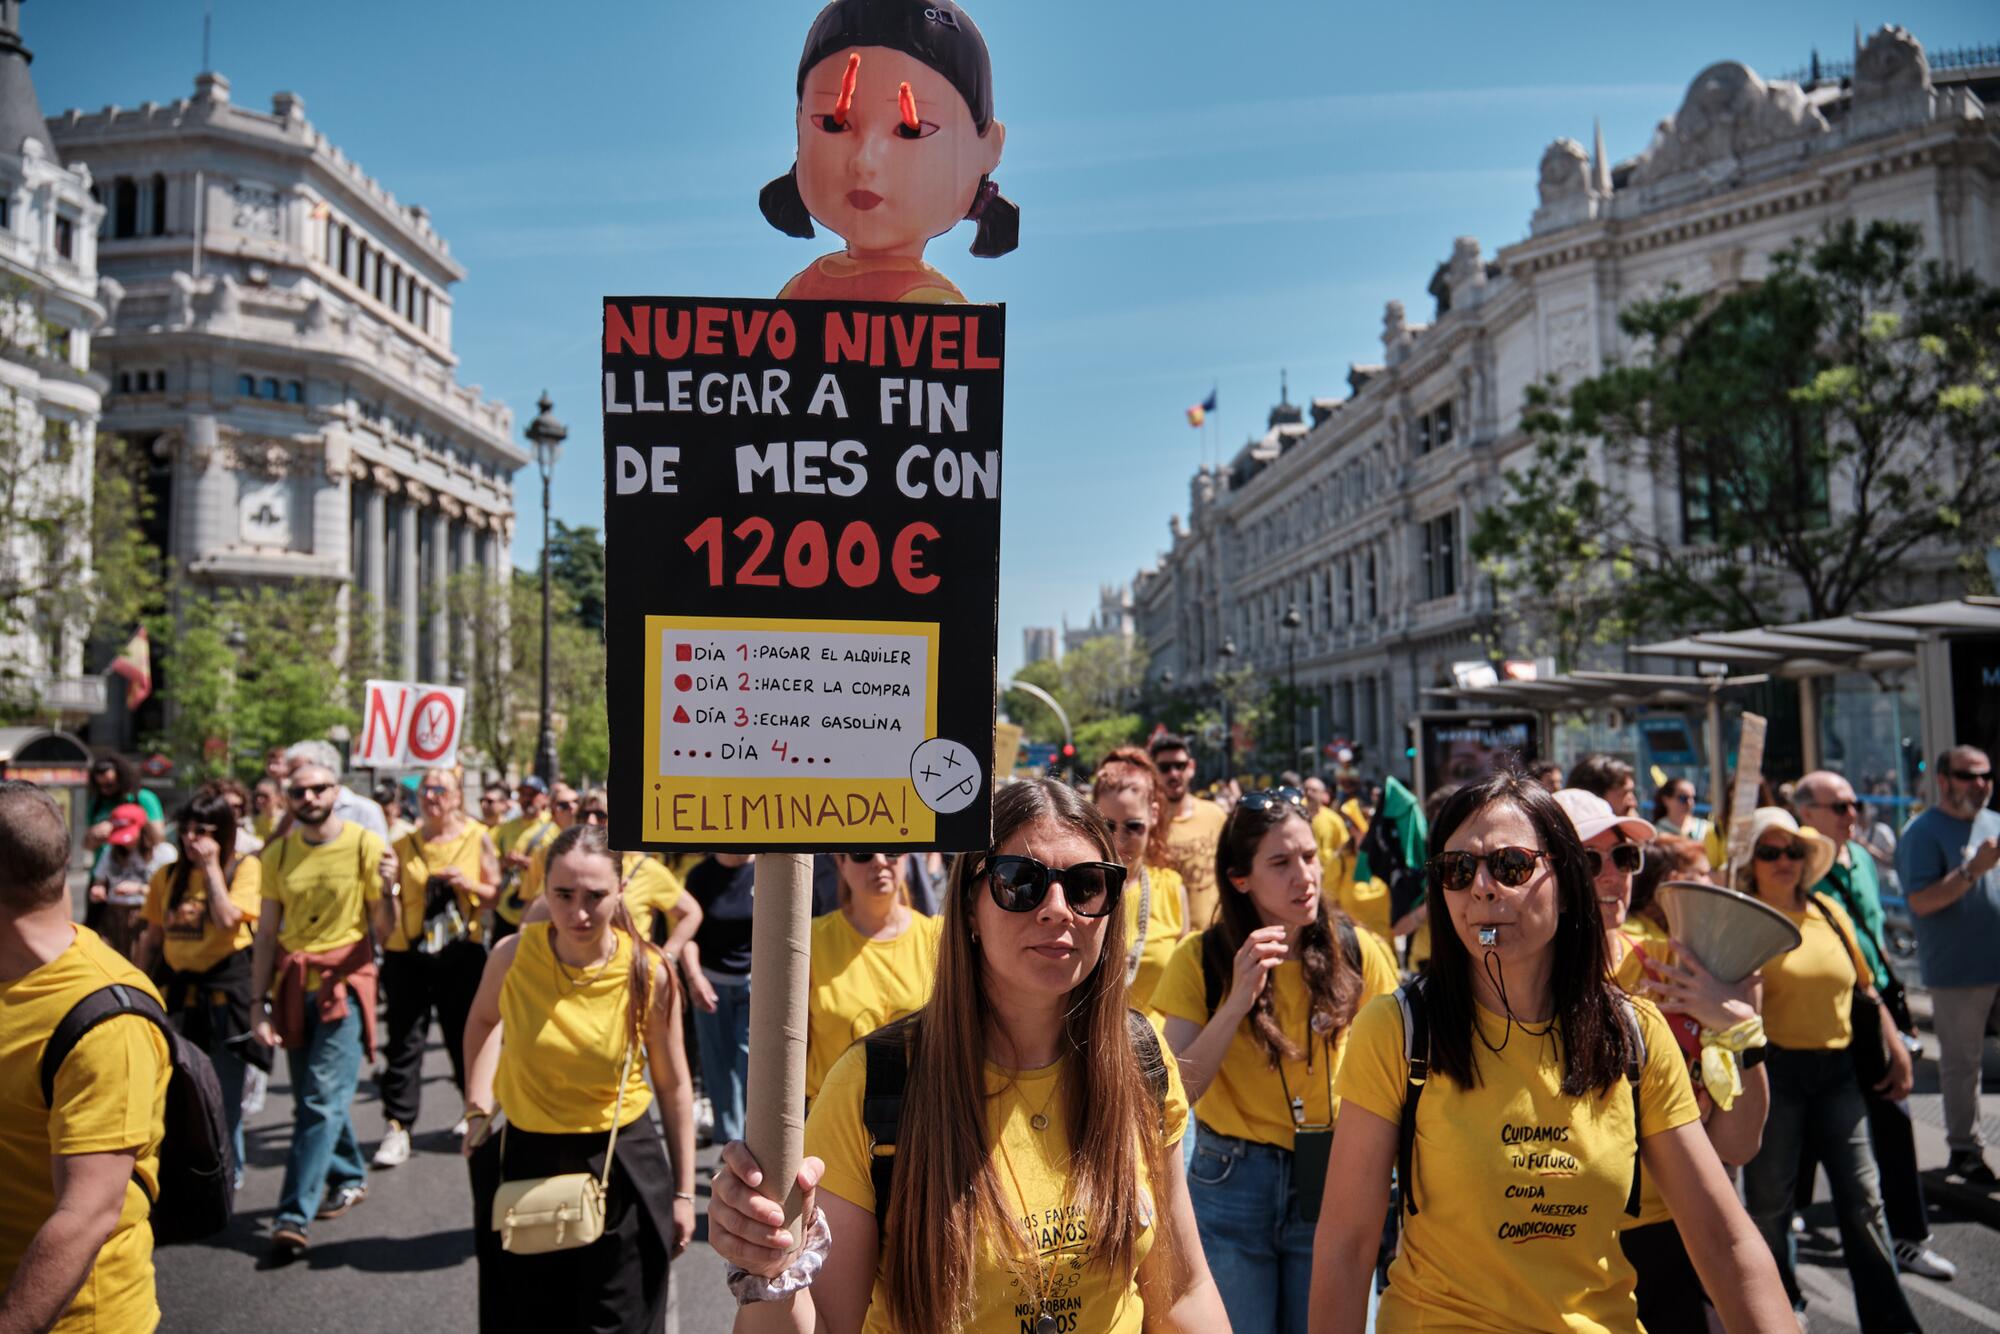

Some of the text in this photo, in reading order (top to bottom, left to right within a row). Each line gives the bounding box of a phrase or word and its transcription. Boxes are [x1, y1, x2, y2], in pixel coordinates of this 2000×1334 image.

[606, 304, 1000, 370] NUEVO NIVEL
[605, 369, 969, 433] LLEGAR A FIN
[616, 440, 999, 499] DE MES CON
[684, 516, 942, 594] 1200€
[694, 642, 726, 661] DÍA
[821, 648, 838, 661] EL
[823, 680, 842, 694] LA
[852, 682, 911, 697] COMPRA
[364, 687, 456, 761] NO
[696, 706, 726, 724] DÍA
[654, 783, 909, 836] ¡ELIMINADA!
[1501, 1124, 1569, 1144] CUIDAMOS
[1512, 1153, 1578, 1170] TU FUTURO,
[1505, 1185, 1545, 1198] CUIDA
[1531, 1203, 1589, 1216] NUESTRAS
[1021, 1214, 1039, 1229] OS
[1498, 1221, 1577, 1239] CONDICIONES
[1040, 1297, 1082, 1313] SOBRAN
